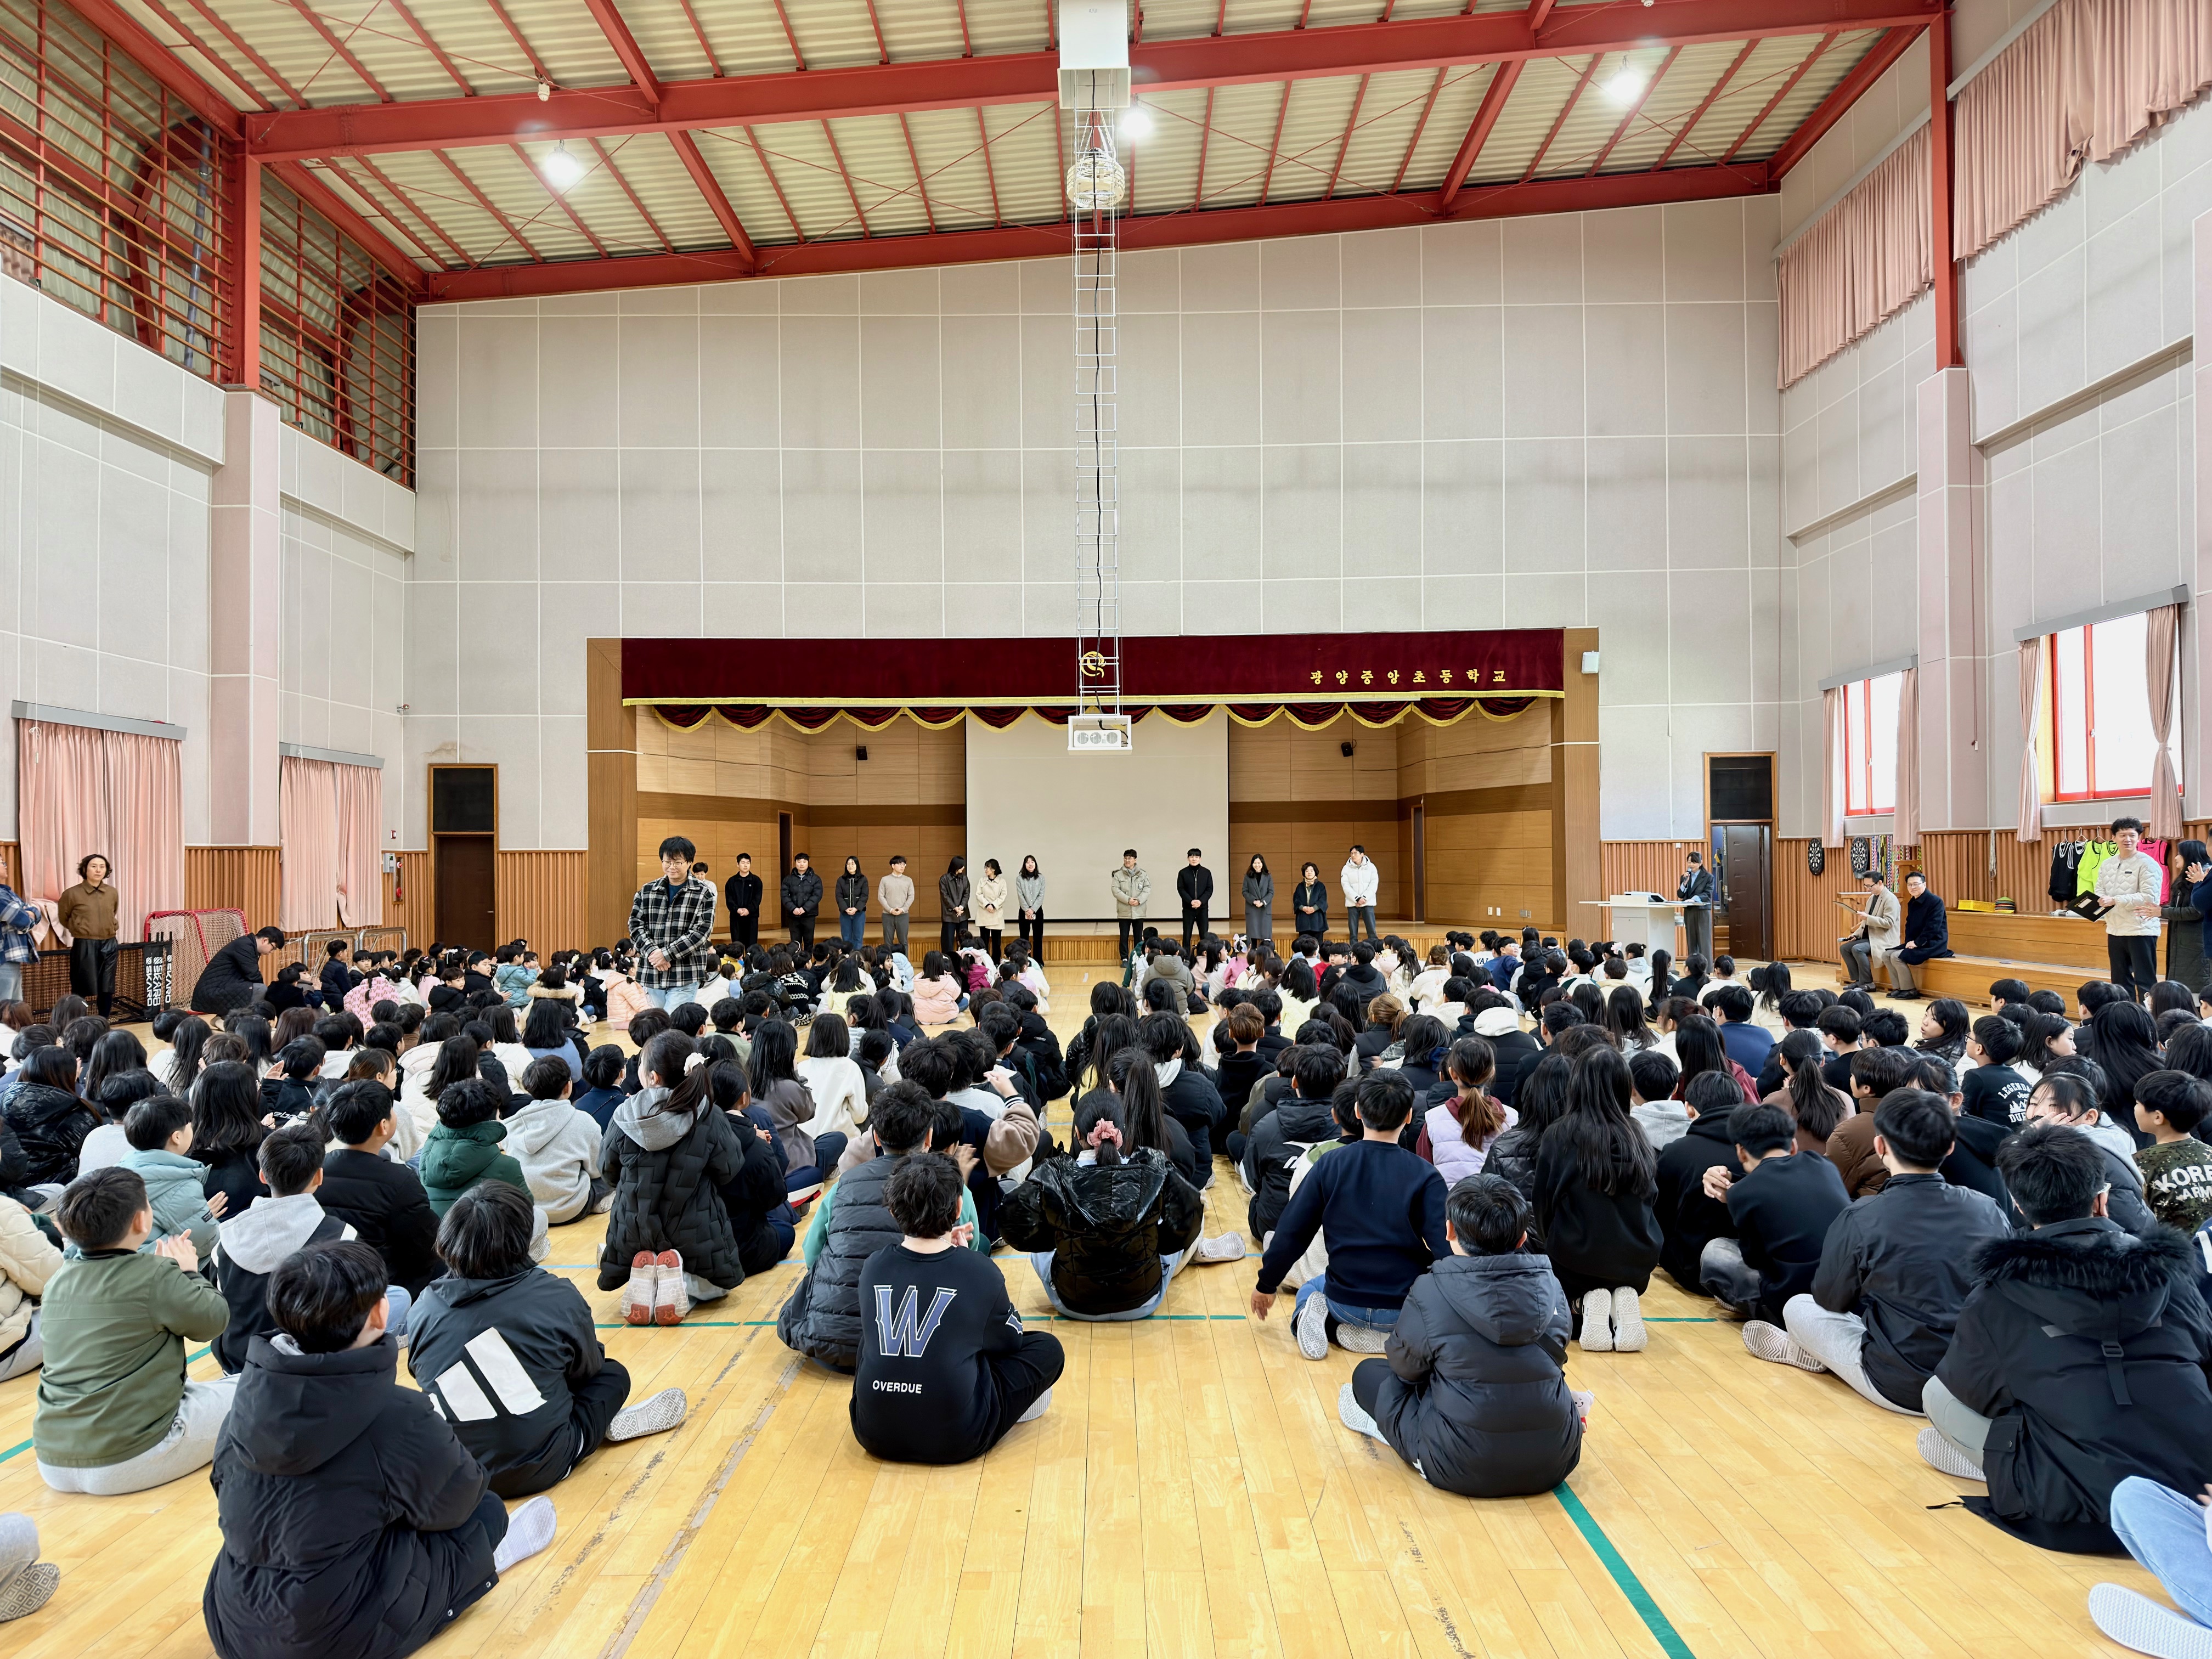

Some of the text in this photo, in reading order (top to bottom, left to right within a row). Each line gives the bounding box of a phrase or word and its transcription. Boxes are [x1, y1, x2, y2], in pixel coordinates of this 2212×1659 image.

[1310, 668, 1506, 685] 광양중앙초등학교
[1997, 1082, 2032, 1099] LEGENDA
[873, 1285, 957, 1358] W
[872, 1380, 922, 1394] OVERDUE
